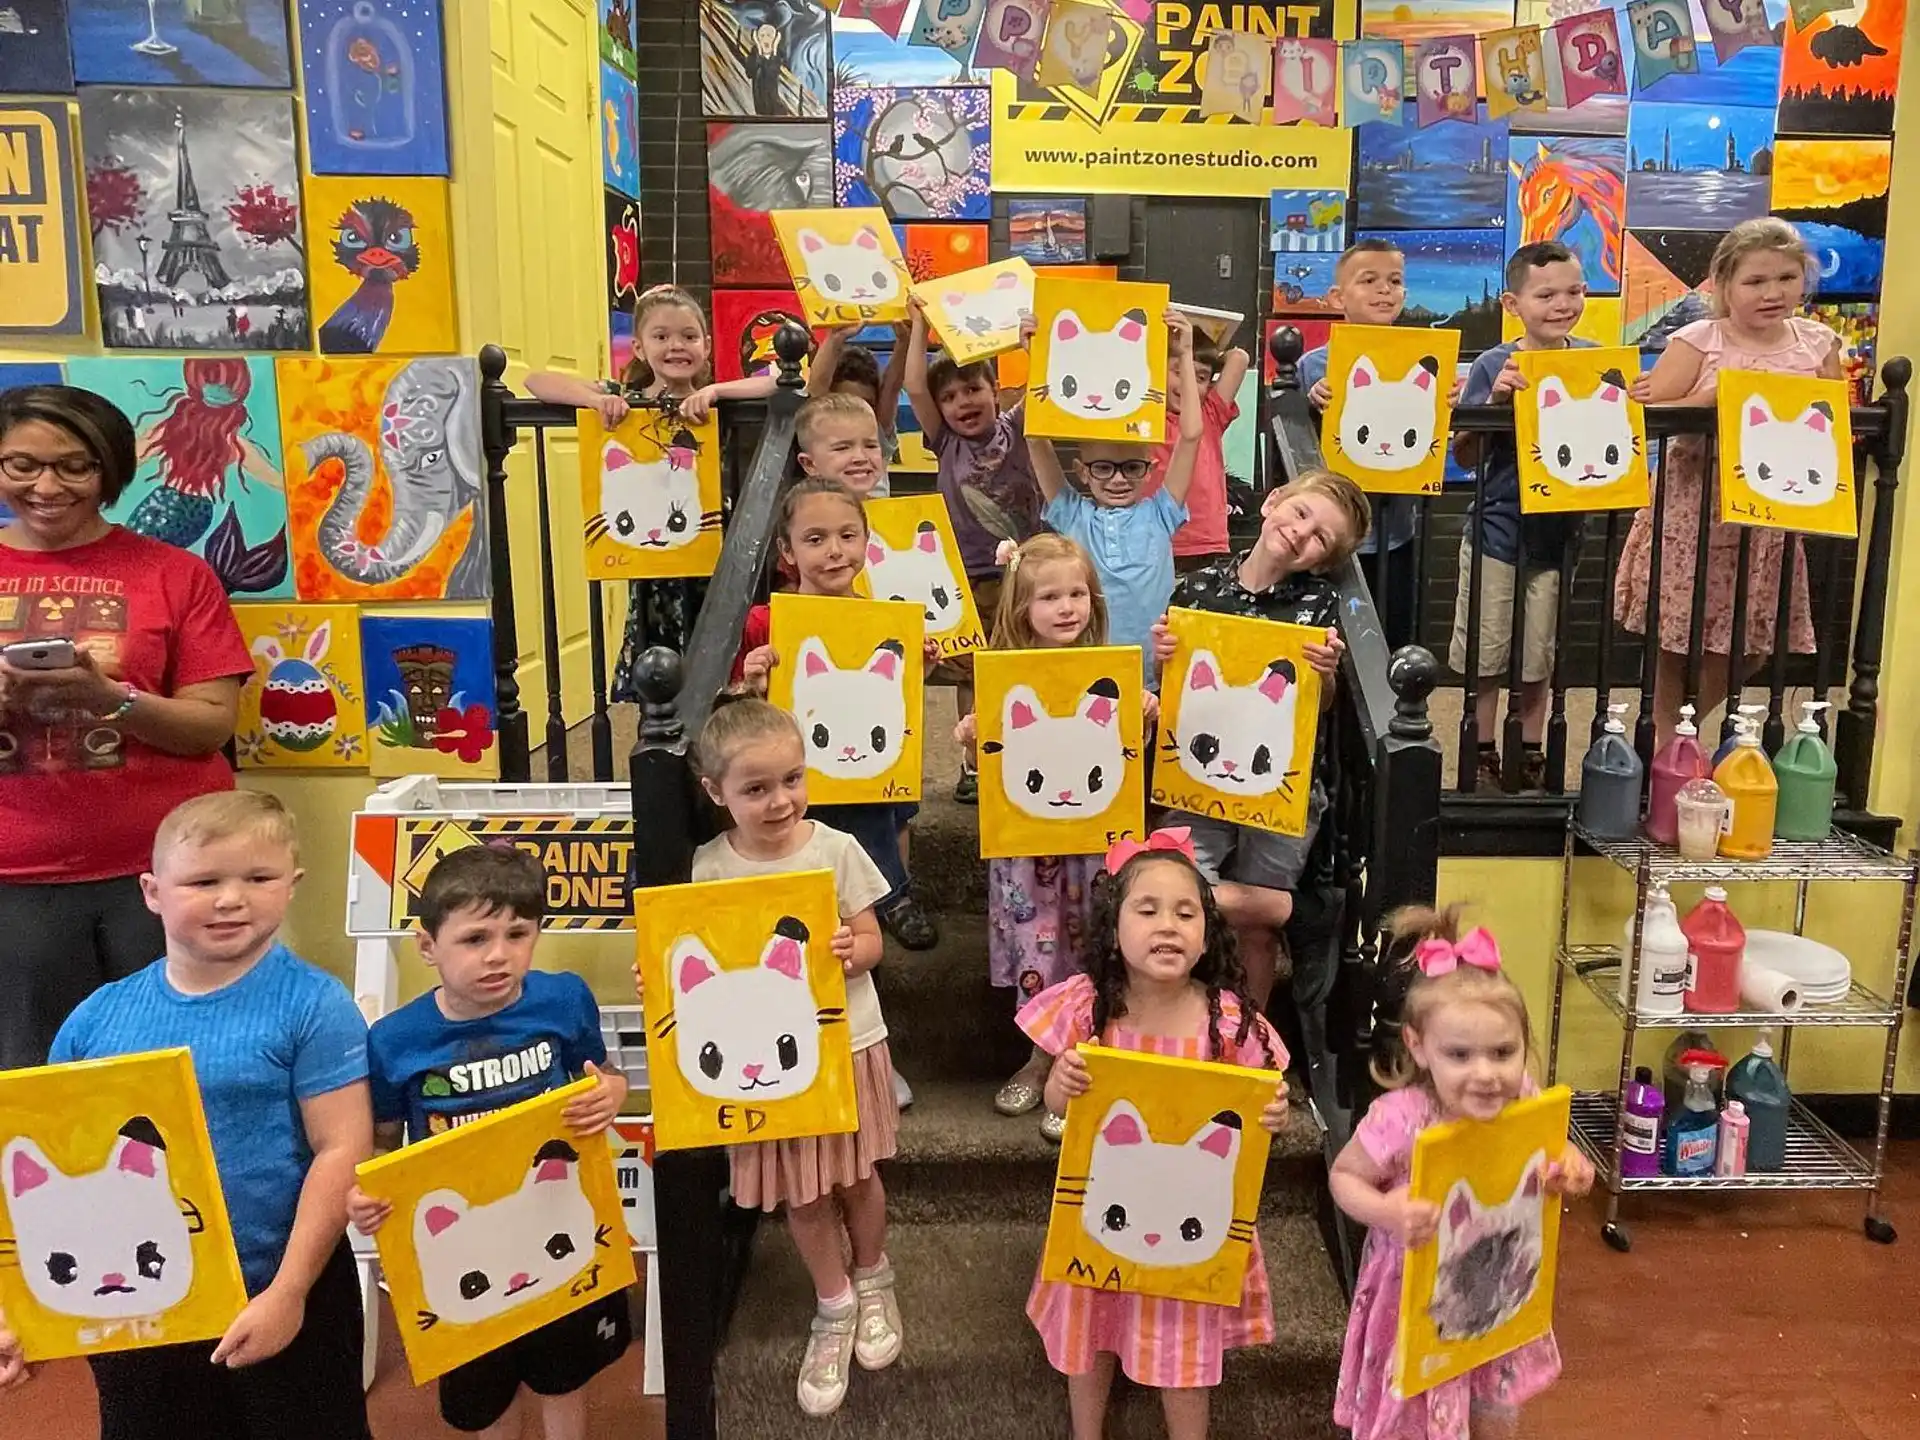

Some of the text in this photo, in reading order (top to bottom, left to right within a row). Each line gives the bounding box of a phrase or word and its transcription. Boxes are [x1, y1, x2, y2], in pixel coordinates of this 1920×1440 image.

[1156, 2, 1321, 47] PAINT
[1024, 147, 1318, 169] www.paintzonestudio.com
[25, 576, 46, 594] IN
[49, 576, 125, 596] SCIENCE
[546, 874, 626, 908] ONE
[449, 1041, 552, 1093] STRONG
[718, 1104, 767, 1133] ED
